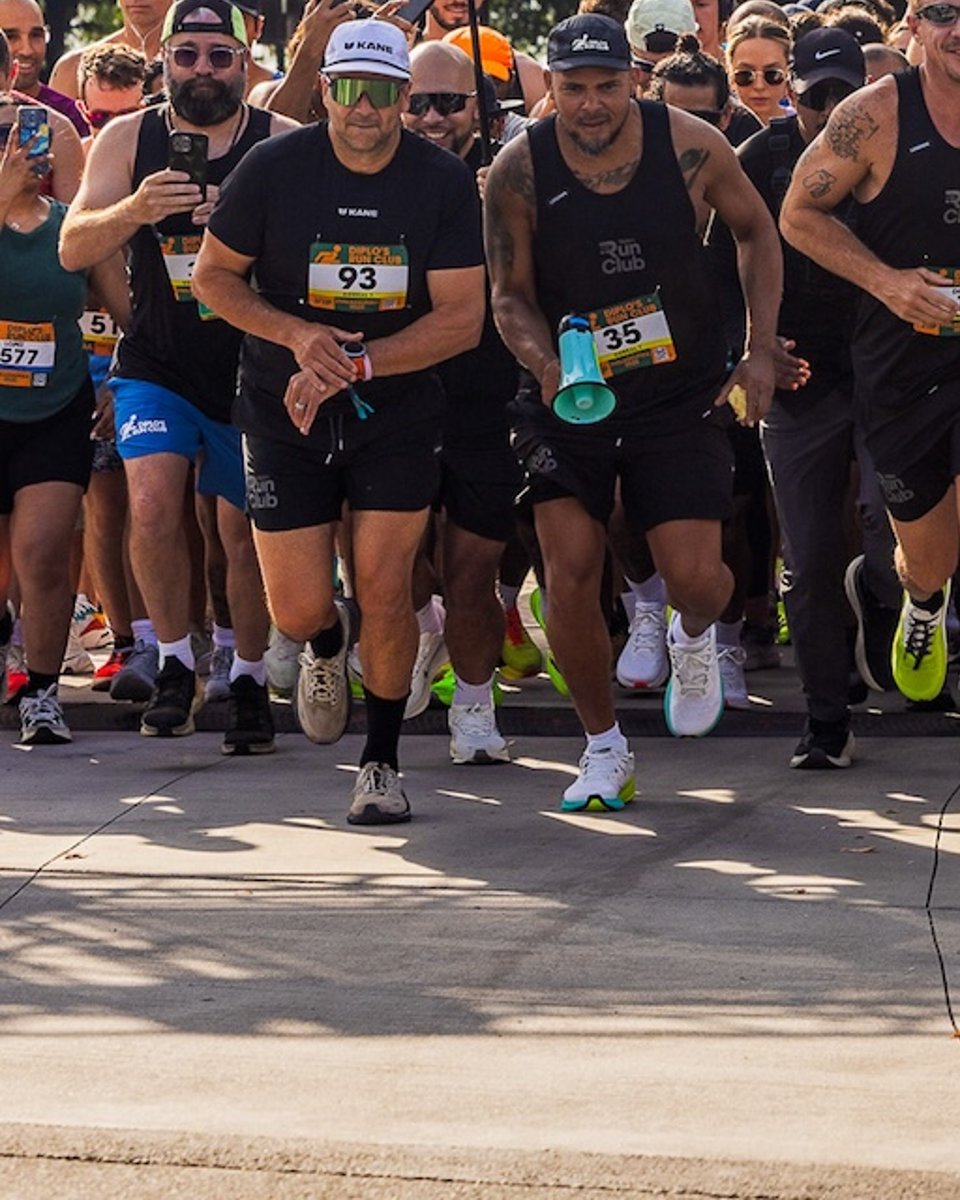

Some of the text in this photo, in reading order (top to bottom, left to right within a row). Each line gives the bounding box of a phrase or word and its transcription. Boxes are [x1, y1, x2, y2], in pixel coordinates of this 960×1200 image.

[356, 41, 393, 55] KANE
[348, 208, 378, 218] KANE
[349, 246, 391, 256] DIPLO'S
[599, 240, 642, 258] Run
[349, 255, 402, 265] RUN CLUB
[601, 256, 645, 274] Club
[339, 266, 377, 290] 93
[603, 322, 642, 350] 35
[1, 348, 39, 365] 577
